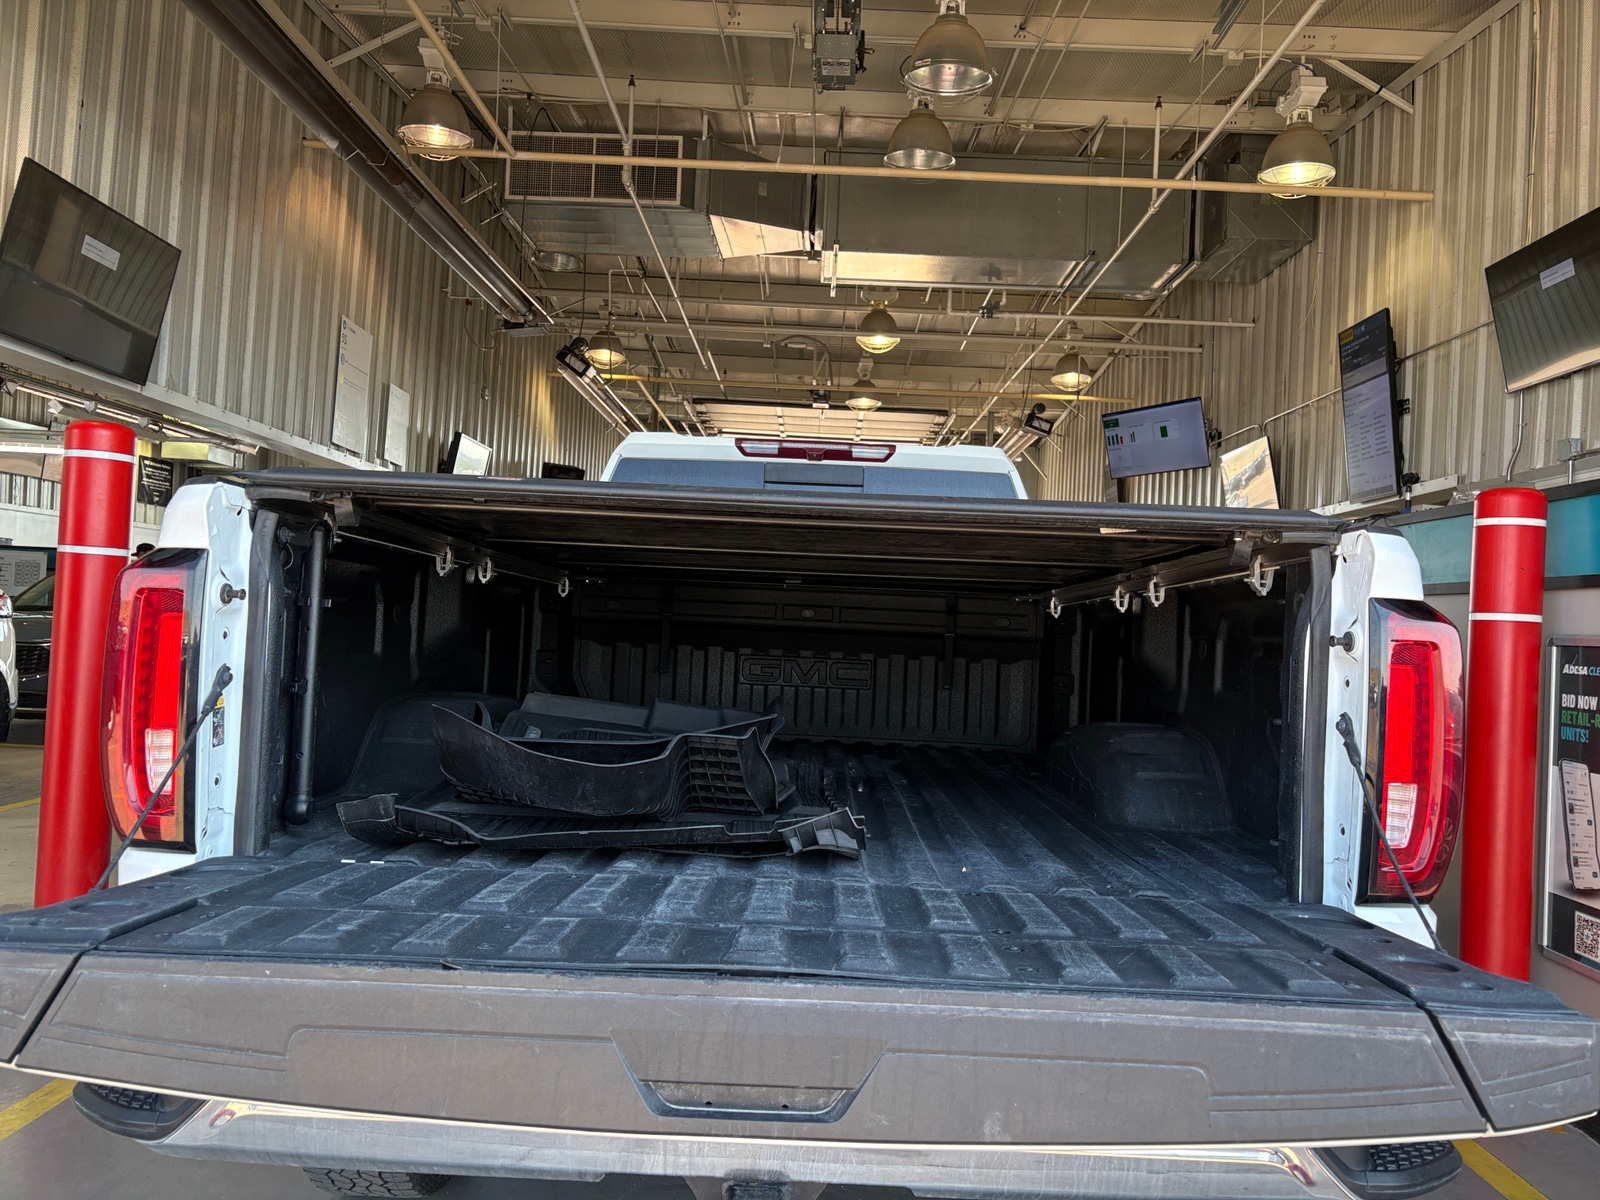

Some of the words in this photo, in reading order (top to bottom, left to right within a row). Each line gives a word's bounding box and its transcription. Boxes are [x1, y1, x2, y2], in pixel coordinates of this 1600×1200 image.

[741, 657, 870, 687] GMC
[1562, 664, 1588, 675] ADESA
[1562, 693, 1576, 708] BID
[1577, 695, 1598, 711] NOW
[1561, 726, 1589, 743] UNITS!
